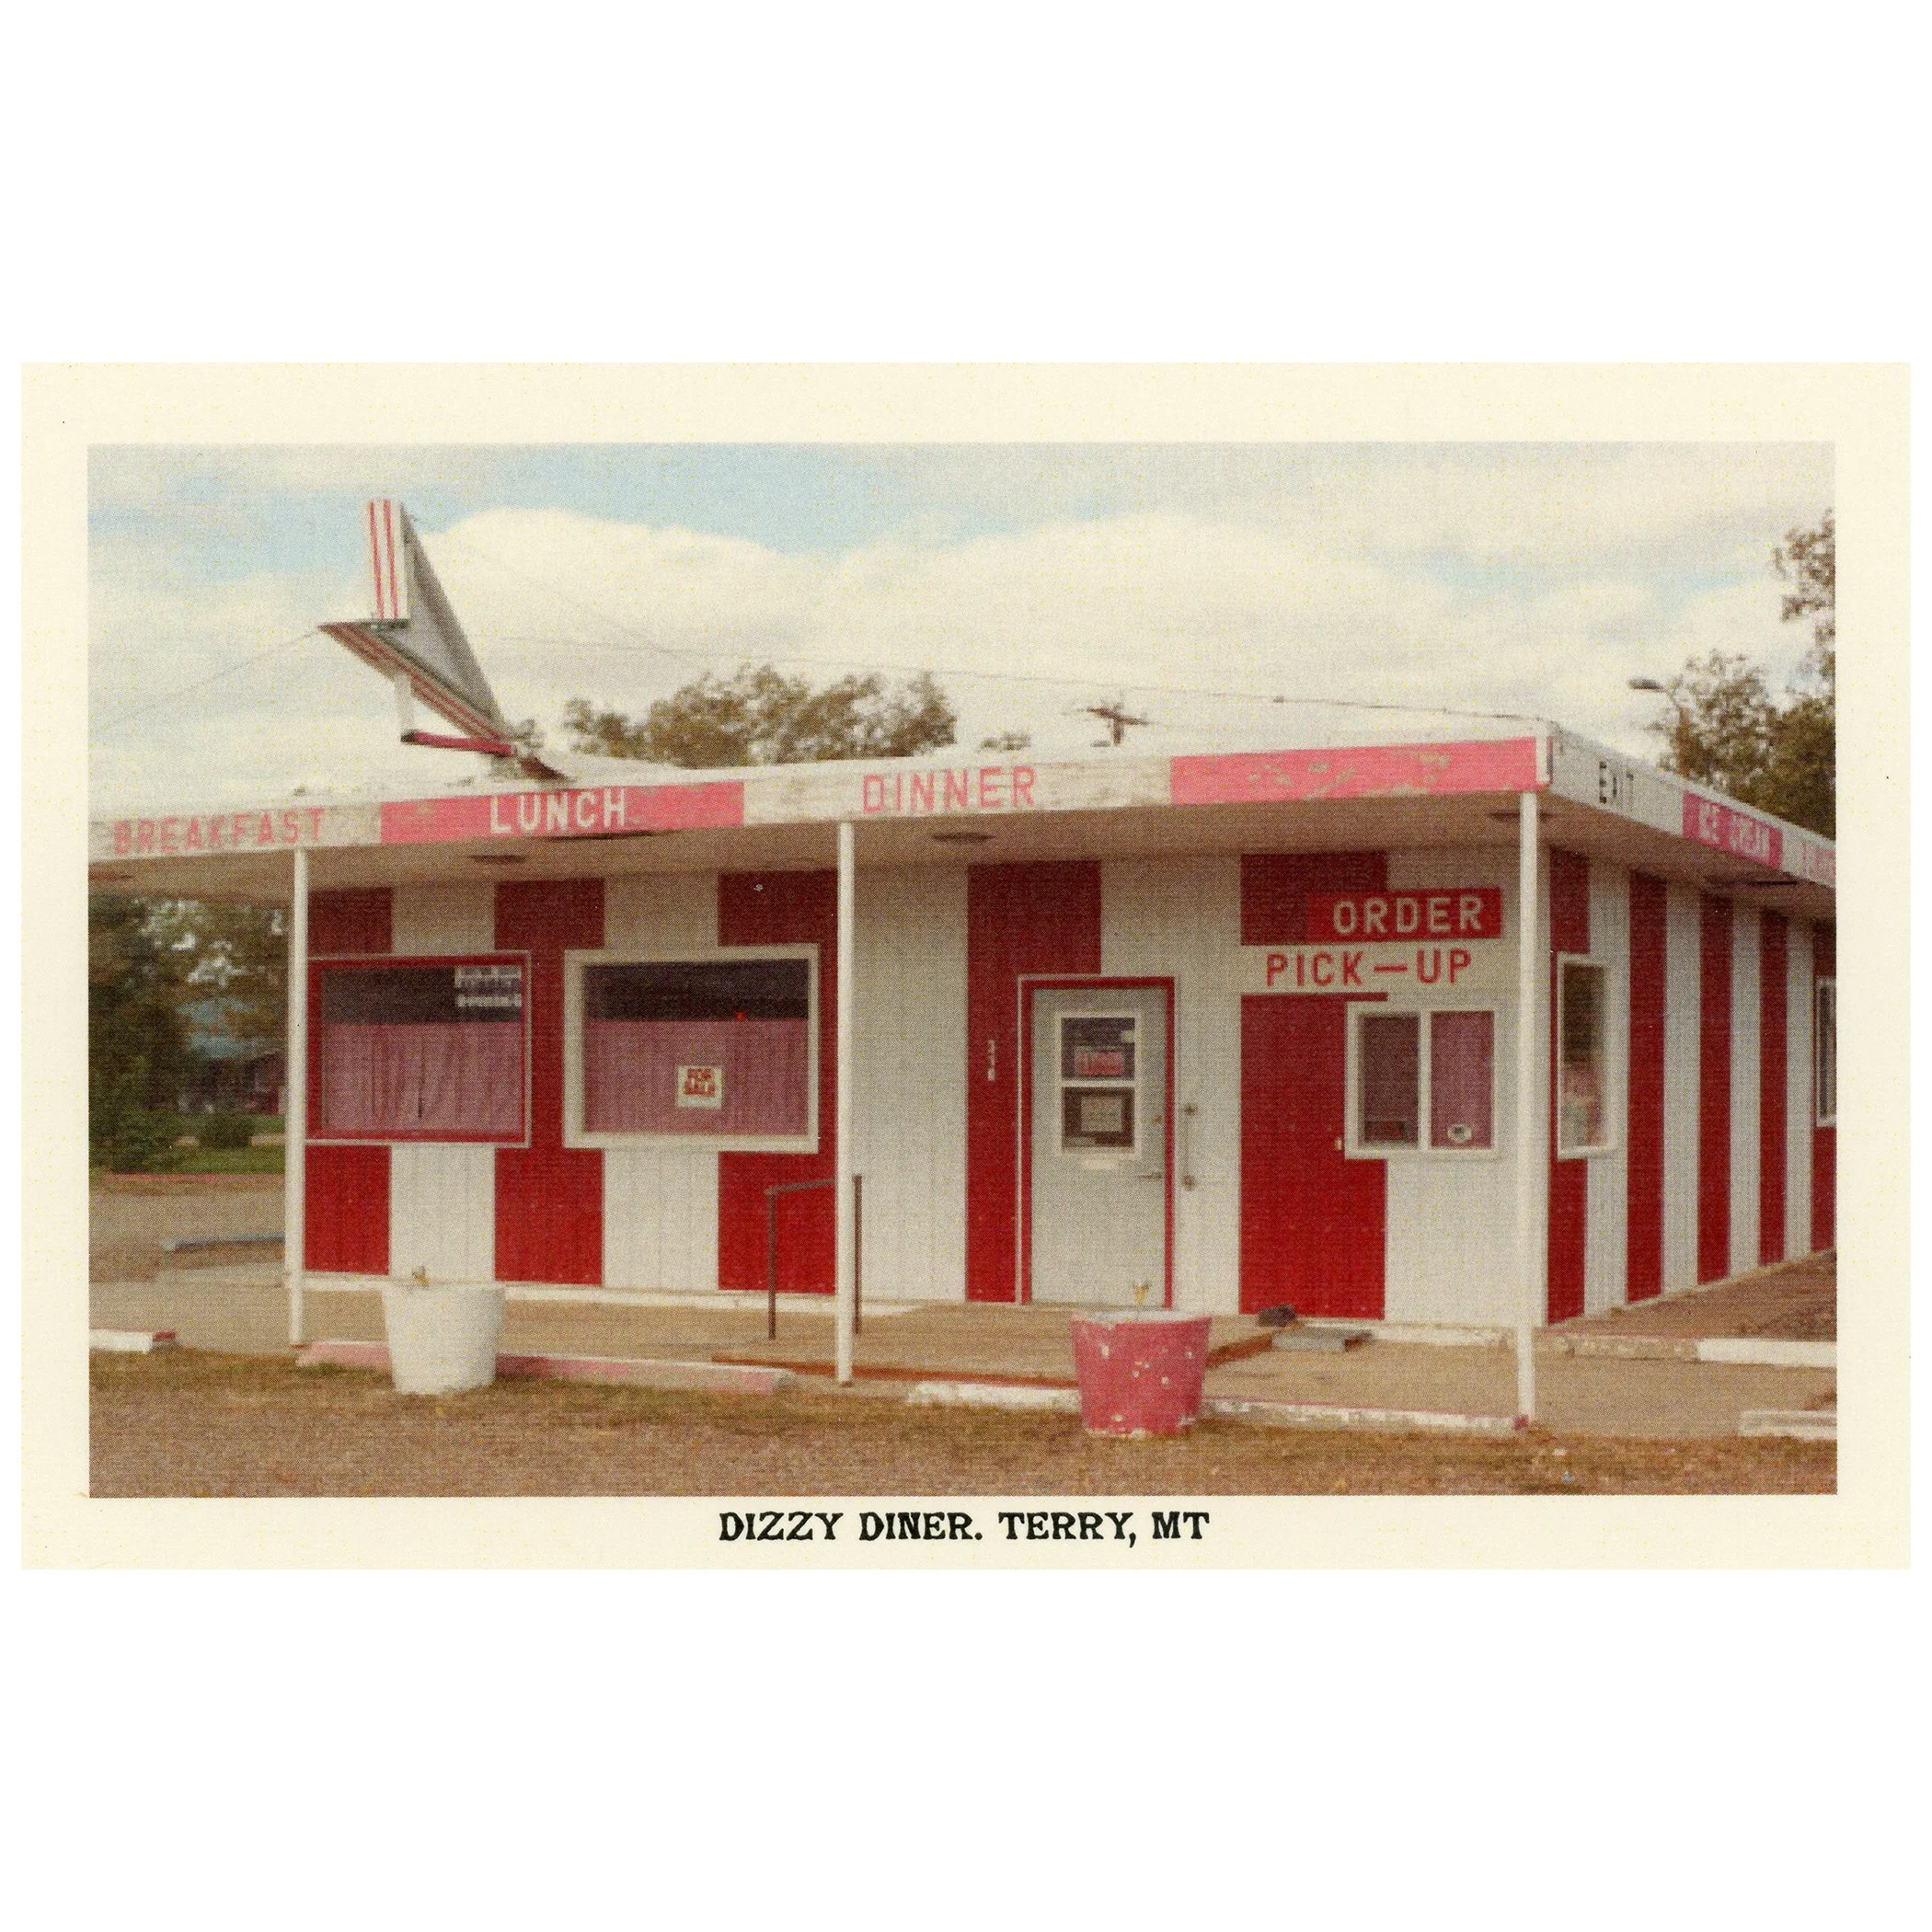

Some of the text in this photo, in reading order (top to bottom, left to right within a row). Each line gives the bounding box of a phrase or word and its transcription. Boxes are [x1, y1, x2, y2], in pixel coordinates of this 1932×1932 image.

[490, 788, 626, 834] LUNCH
[863, 765, 1035, 813] DINNER
[113, 807, 326, 856] BREAKFAST
[1335, 895, 1485, 935] ORDER
